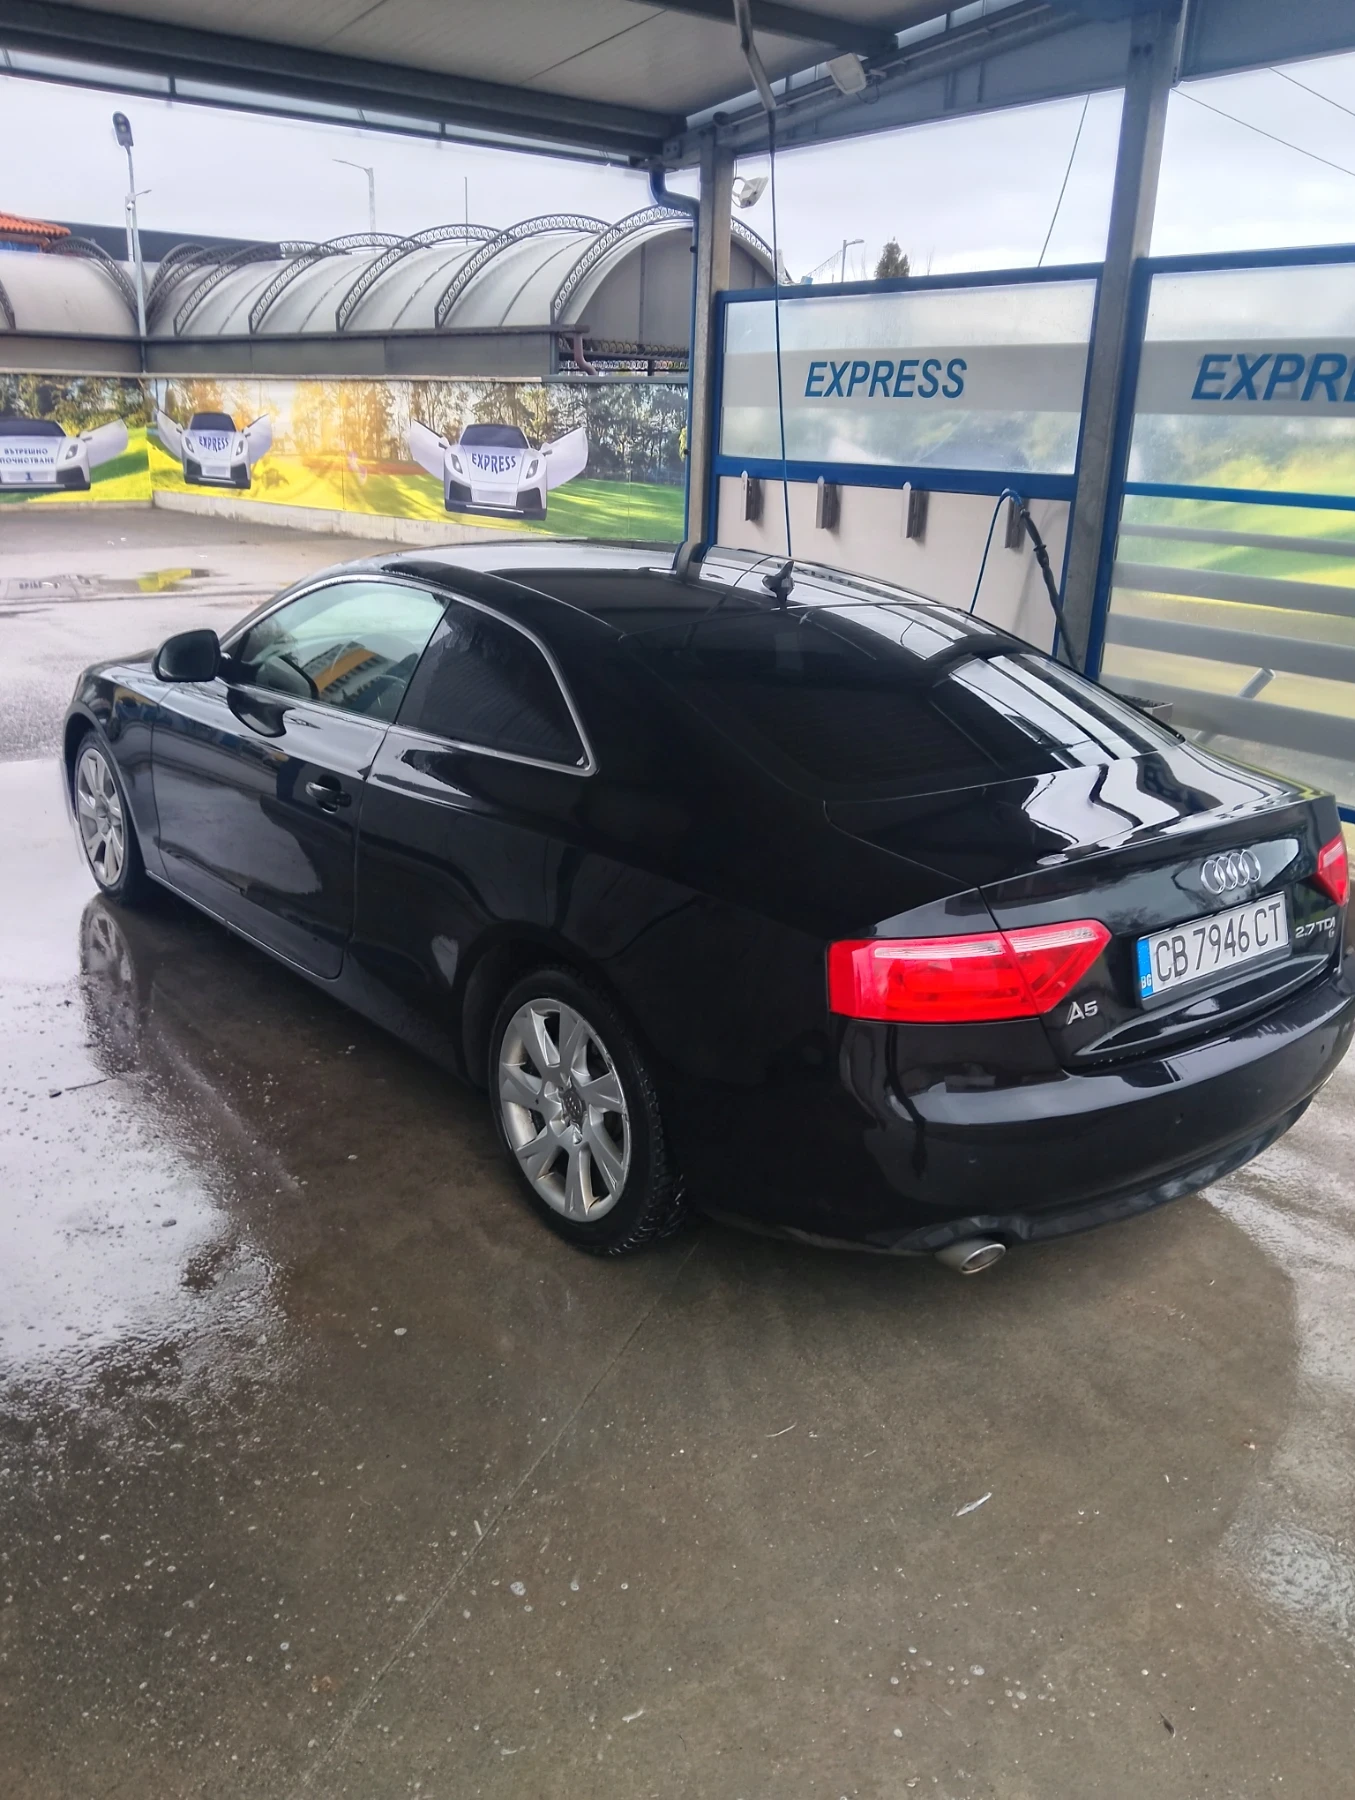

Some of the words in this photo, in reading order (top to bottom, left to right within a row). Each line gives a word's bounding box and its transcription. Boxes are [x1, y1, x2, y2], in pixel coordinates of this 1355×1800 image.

[804, 358, 968, 399] EXPRESS
[198, 435, 229, 453] EXPRESS
[471, 452, 517, 475] EXPRESS
[25, 472, 33, 482] 1
[1140, 973, 1152, 989] BG
[1066, 1000, 1098, 1025] A5
